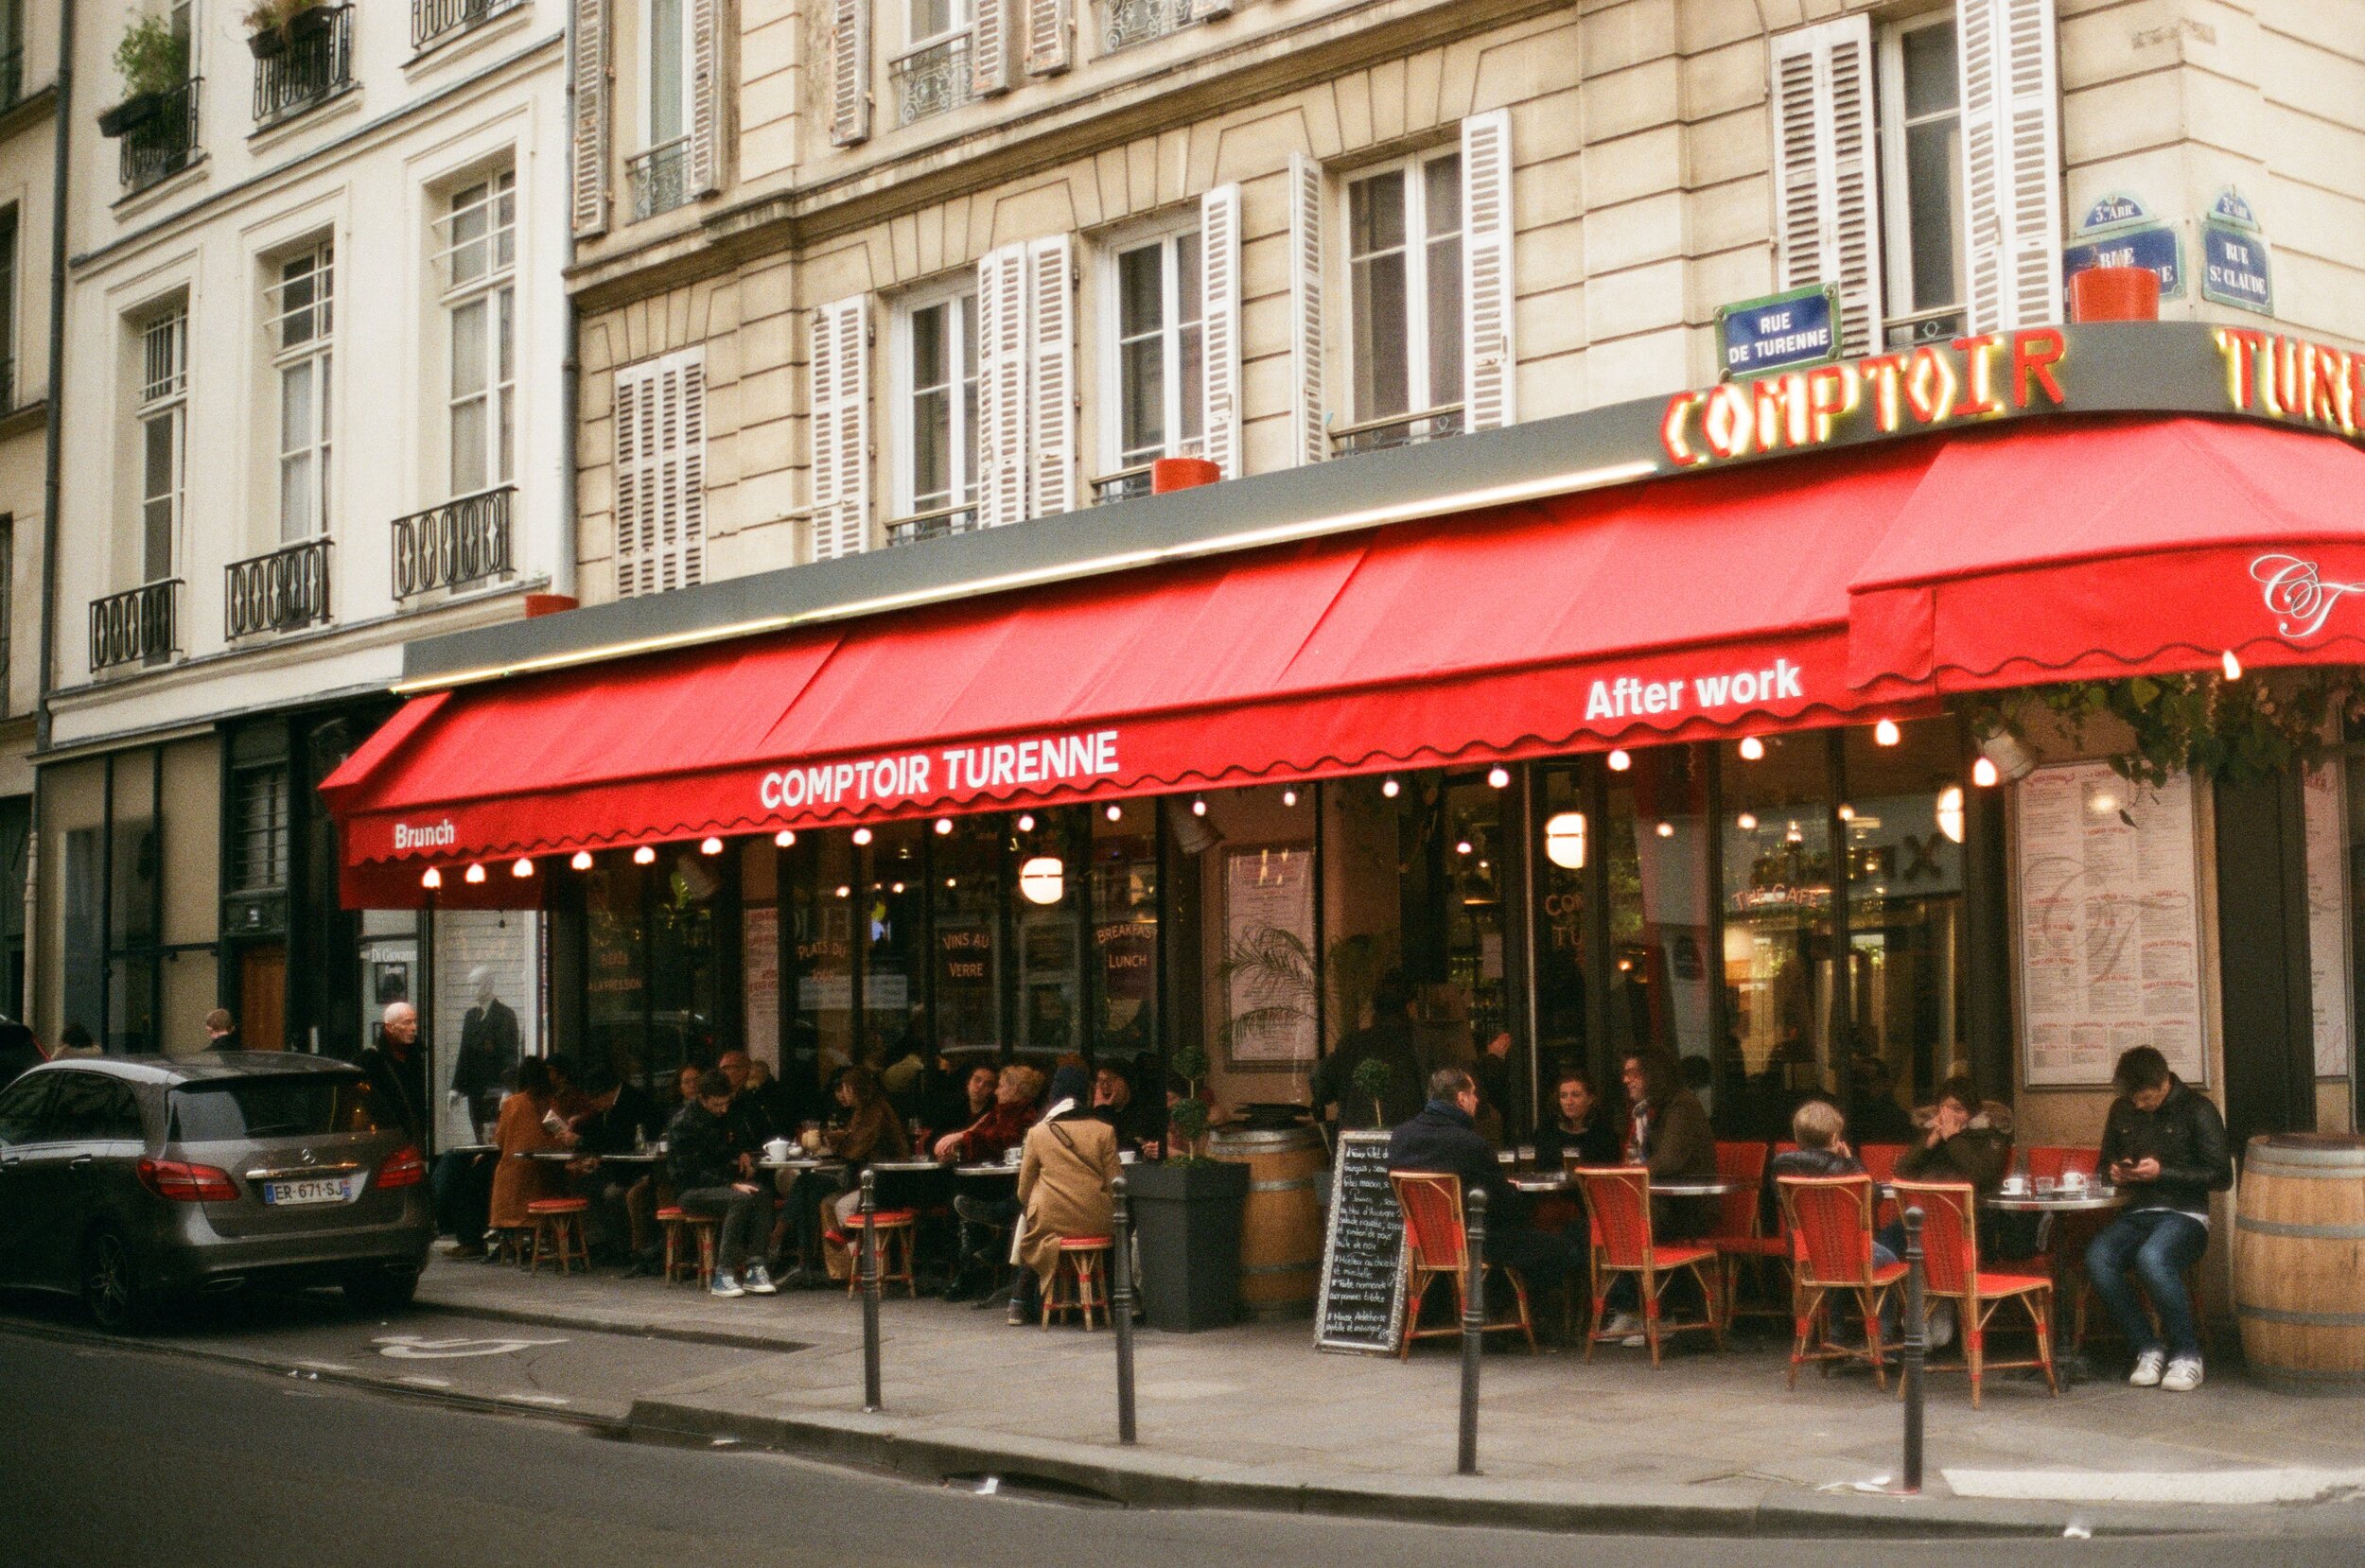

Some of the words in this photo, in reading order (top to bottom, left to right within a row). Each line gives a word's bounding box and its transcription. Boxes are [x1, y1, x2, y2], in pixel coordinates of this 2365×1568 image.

[2099, 248, 2135, 268] RUE
[2226, 242, 2249, 265] RUE
[2224, 270, 2267, 295] CLAUDE
[1761, 312, 1791, 334] RUE
[1729, 345, 1749, 363] DE
[1755, 328, 1829, 358] TURENNE
[1660, 328, 2066, 465] COMPTOIR
[1585, 677, 1684, 721] After
[1695, 658, 1802, 708] work
[761, 755, 929, 809] COMPTOIR
[942, 730, 1119, 791] TURENNE
[394, 818, 454, 849] Brunch
[944, 932, 969, 950] VINS
[972, 932, 990, 949] AU
[950, 962, 985, 977] VERRE
[1109, 953, 1147, 969] LUNCH
[274, 1179, 343, 1200] ER-671-SJ
